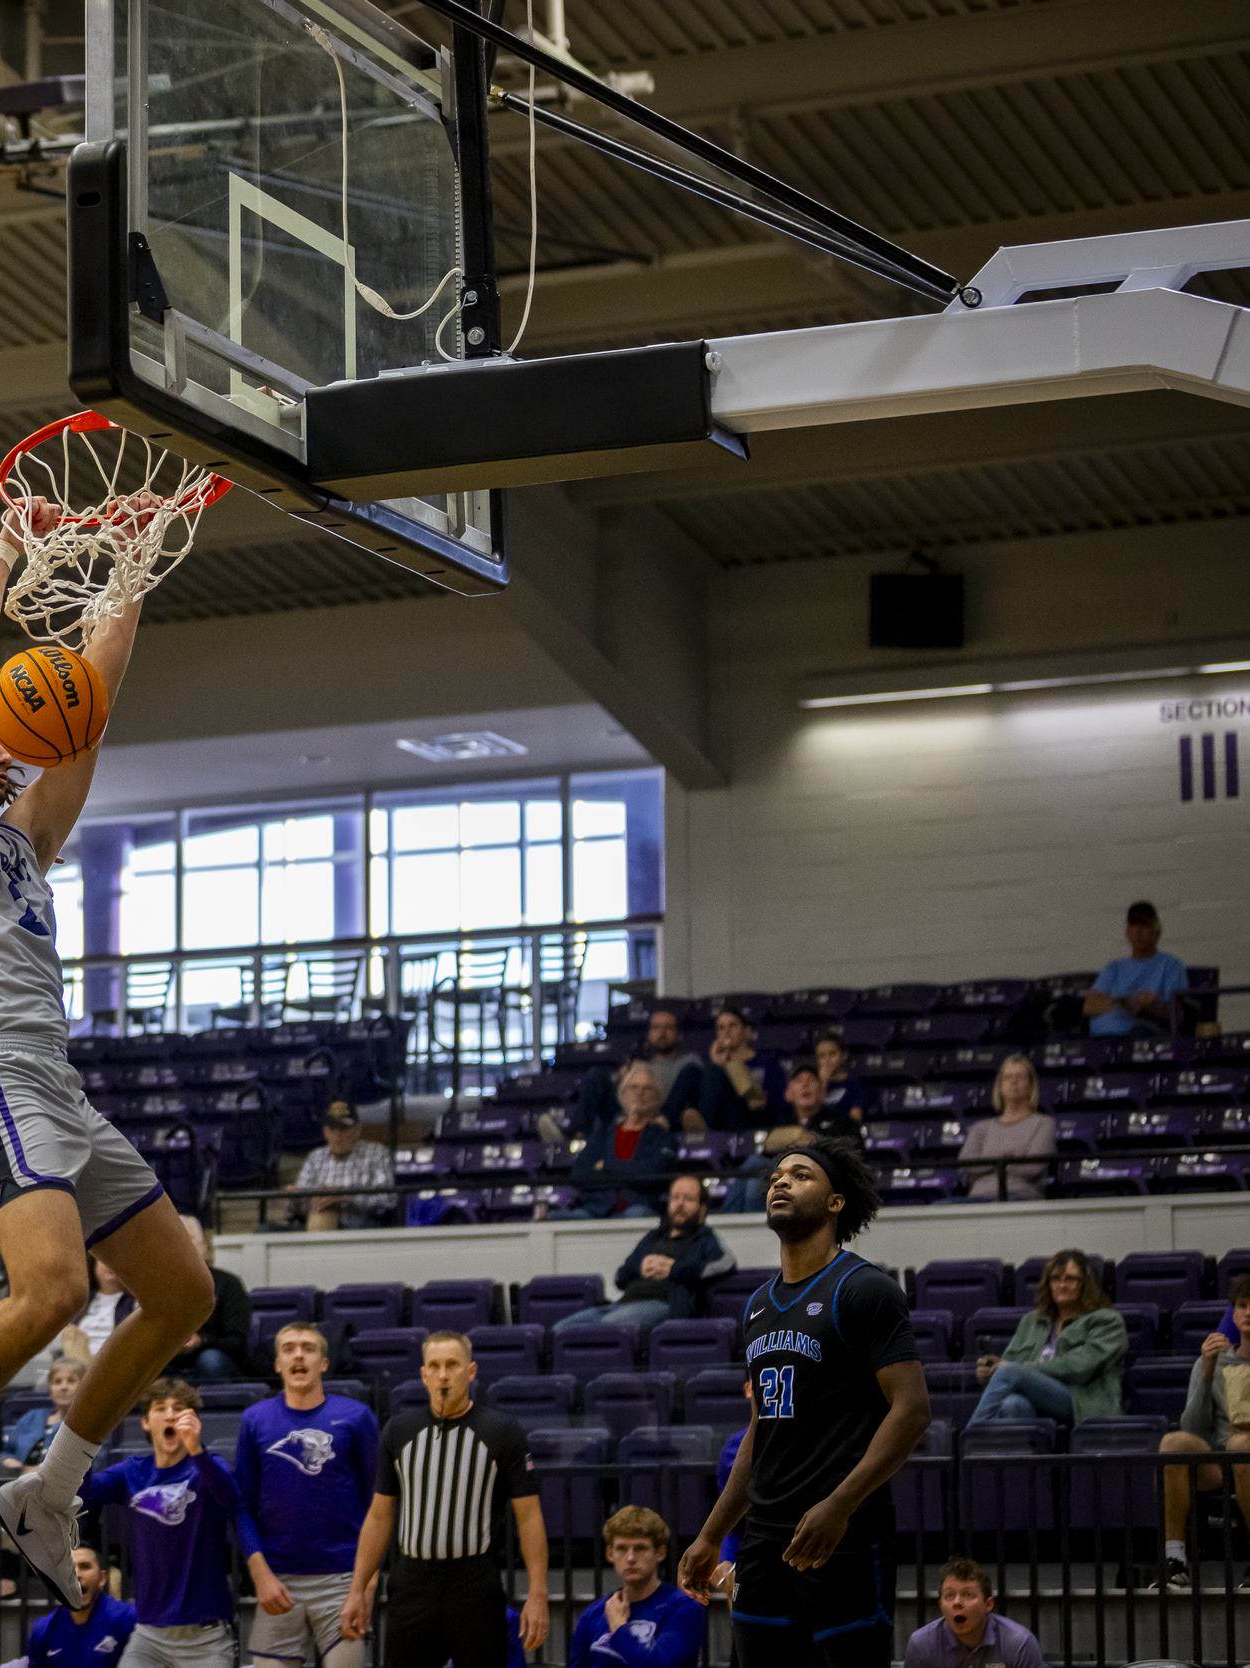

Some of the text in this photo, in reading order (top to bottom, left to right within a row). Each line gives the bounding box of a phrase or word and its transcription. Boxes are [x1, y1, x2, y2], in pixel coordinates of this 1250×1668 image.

[9, 663, 47, 714] NCAA
[38, 647, 81, 710] Wilson
[746, 1330, 822, 1367] WILLIAMS
[759, 1365, 794, 1419] 21
